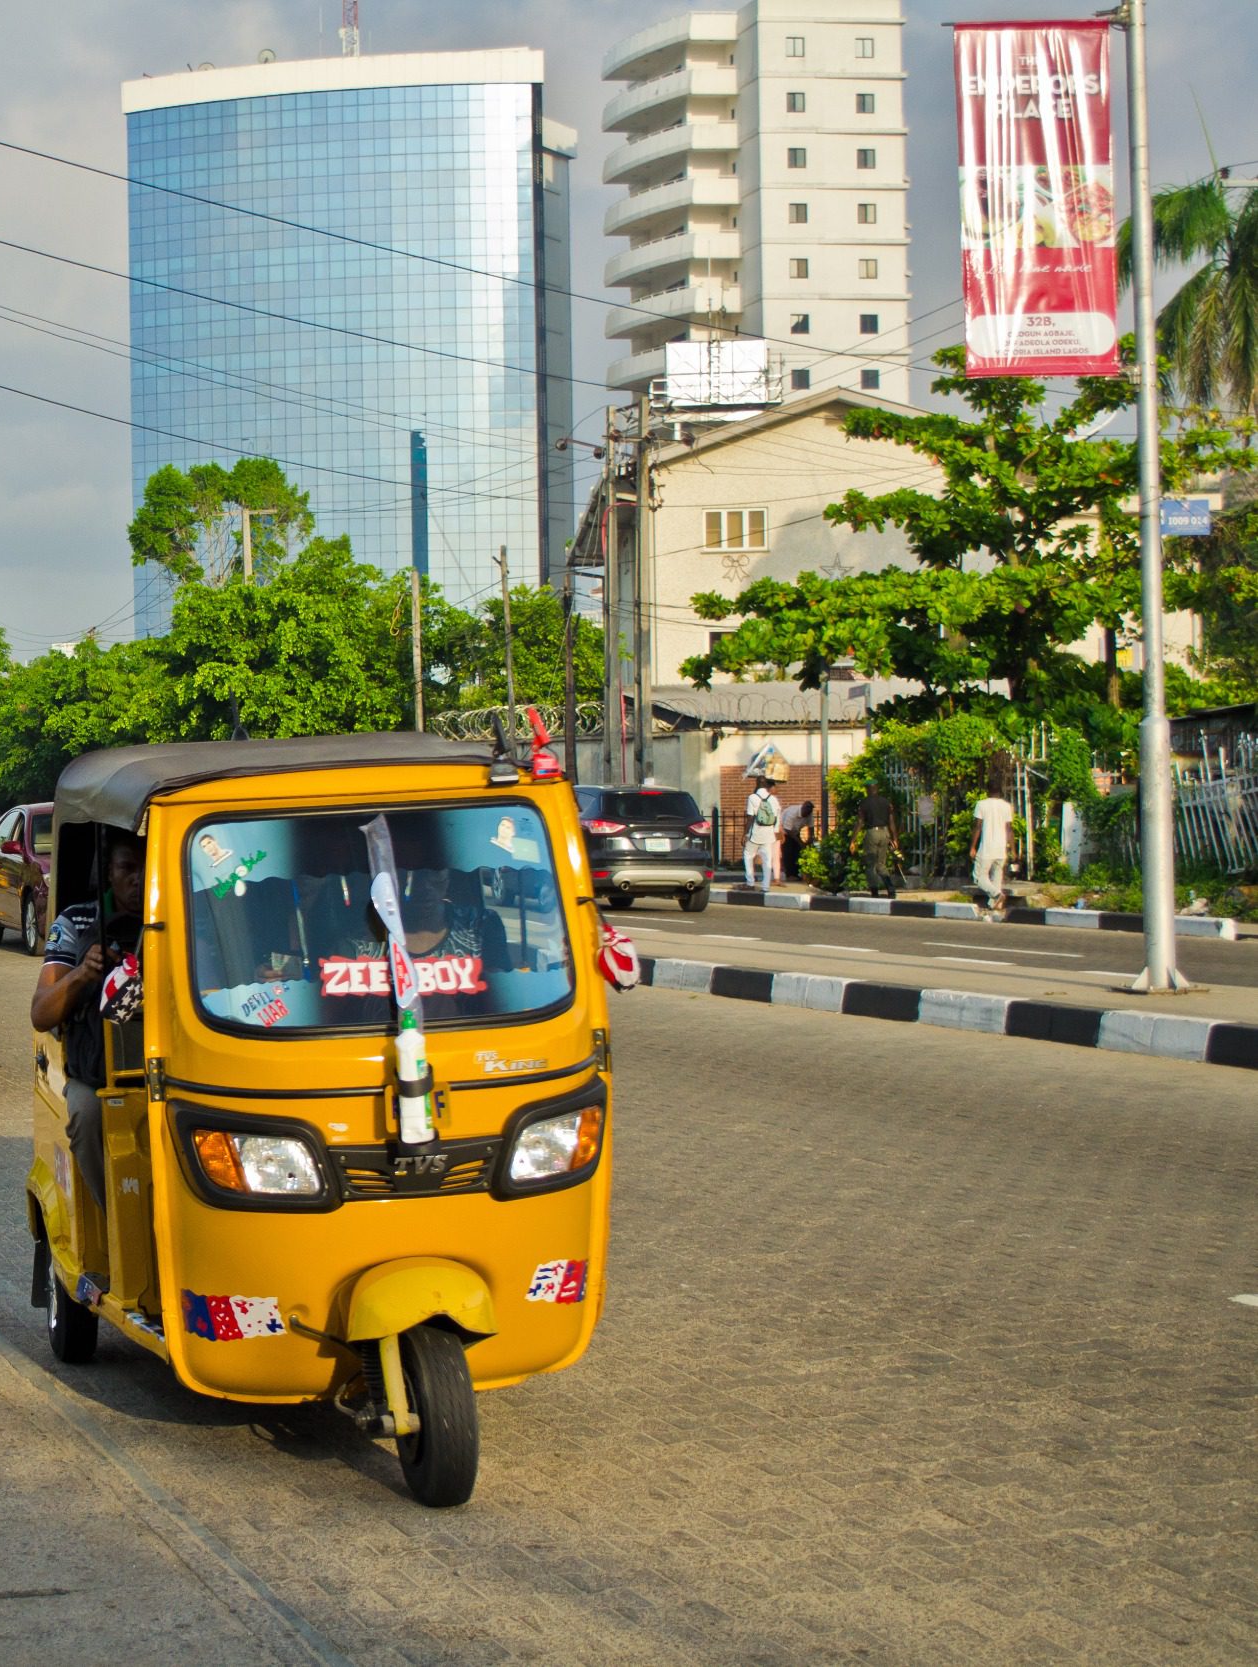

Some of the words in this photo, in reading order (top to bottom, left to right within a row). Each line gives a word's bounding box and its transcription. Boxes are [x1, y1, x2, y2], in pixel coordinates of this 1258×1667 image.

[995, 99, 1073, 119] PLAE
[324, 962, 390, 993] ZEE
[414, 958, 476, 992] BOY
[242, 992, 274, 1017] DEVIL
[257, 998, 290, 1029] LIAR
[476, 1052, 498, 1062] TVS
[394, 1154, 448, 1176] TVS
